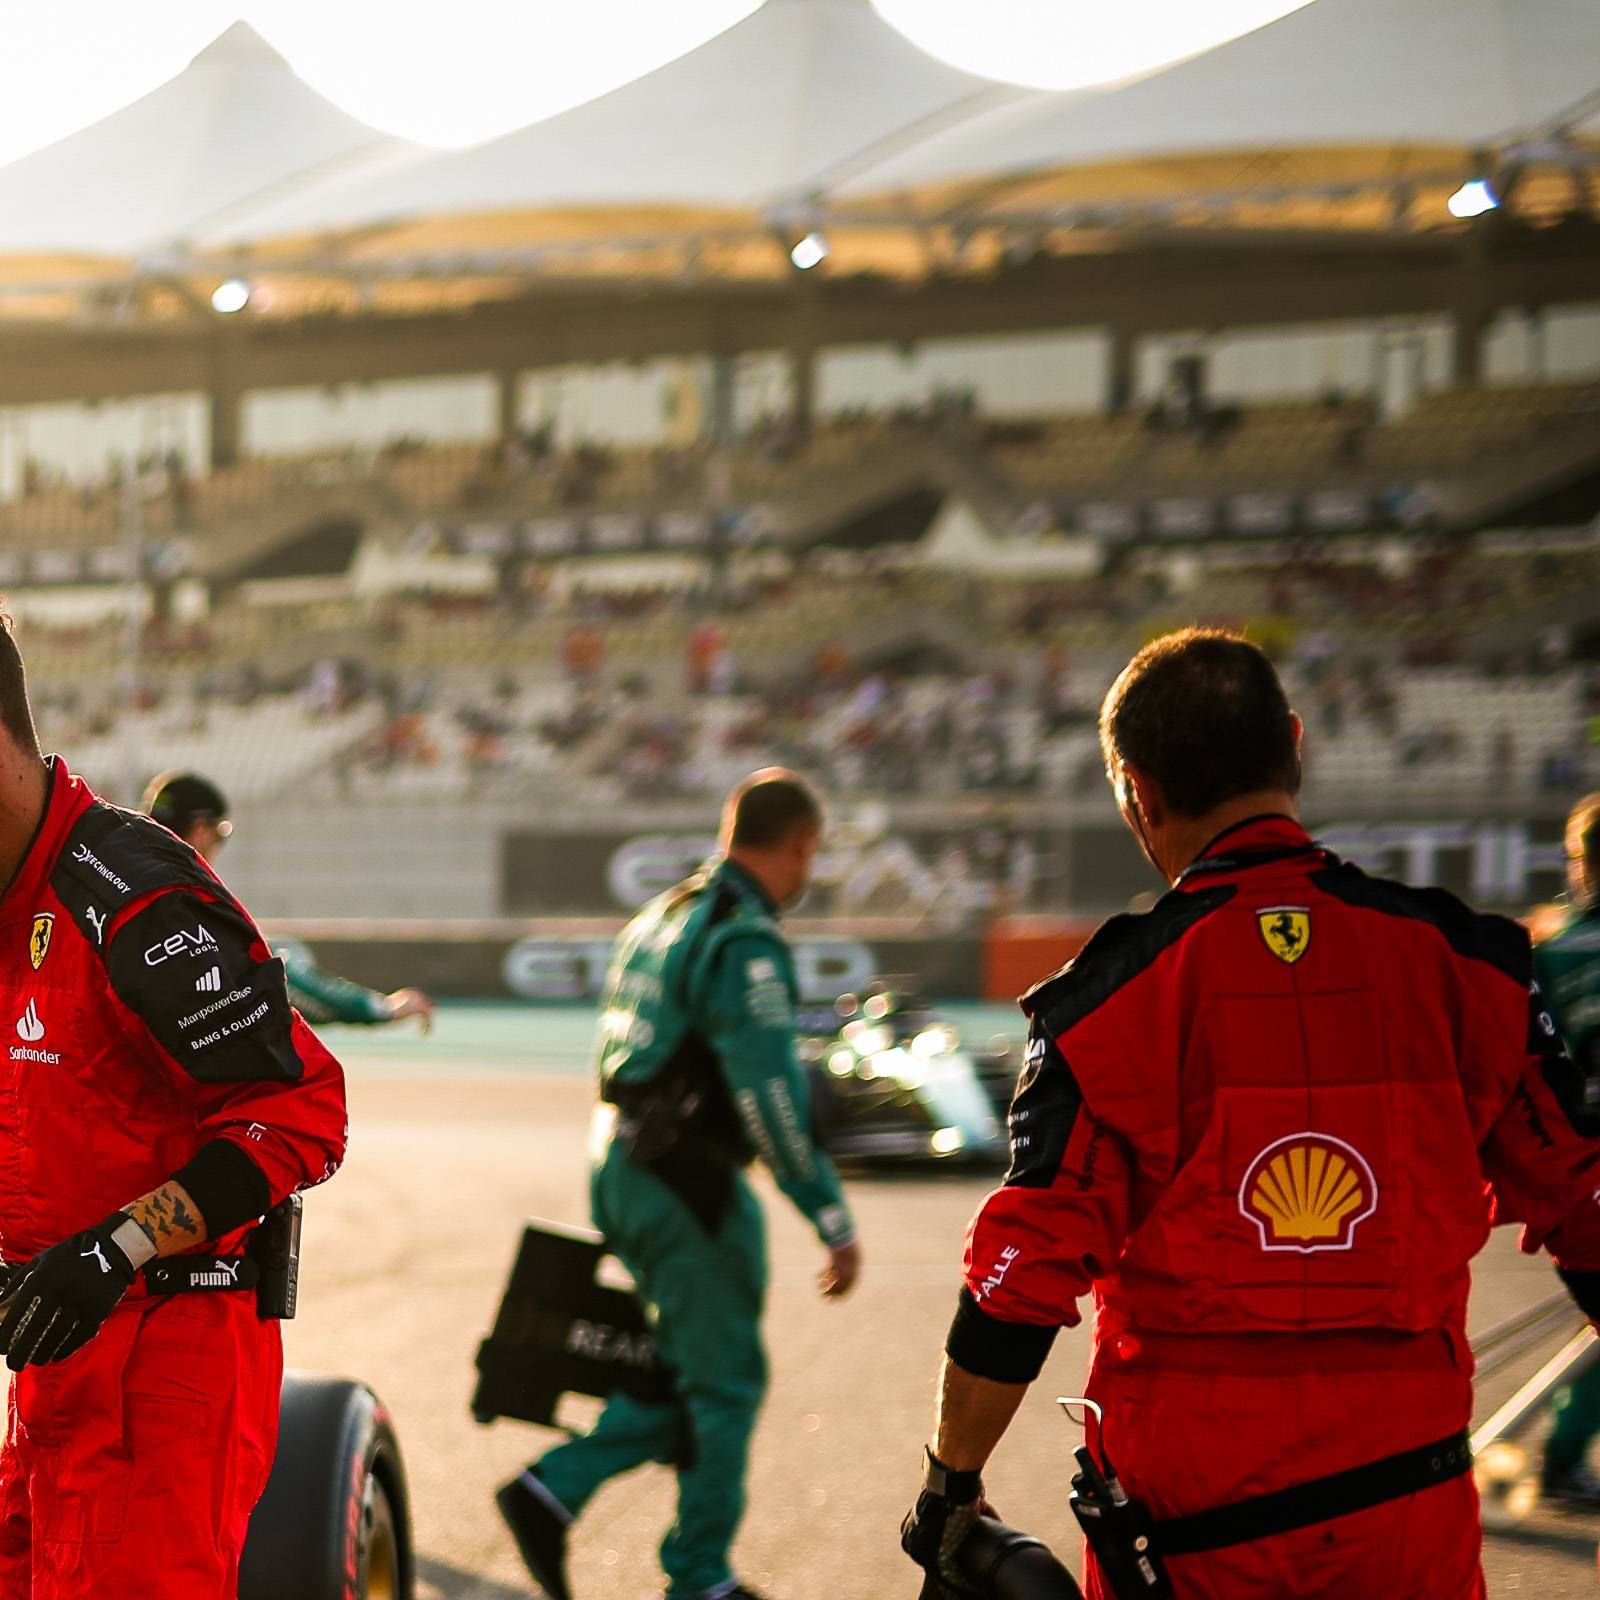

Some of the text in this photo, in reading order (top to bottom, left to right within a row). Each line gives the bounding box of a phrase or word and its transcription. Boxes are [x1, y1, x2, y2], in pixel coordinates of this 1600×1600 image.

[190, 1001, 270, 1051] BANG & OLUFSEN
[9, 1046, 61, 1066] Santander
[189, 1272, 231, 1287] PUMA
